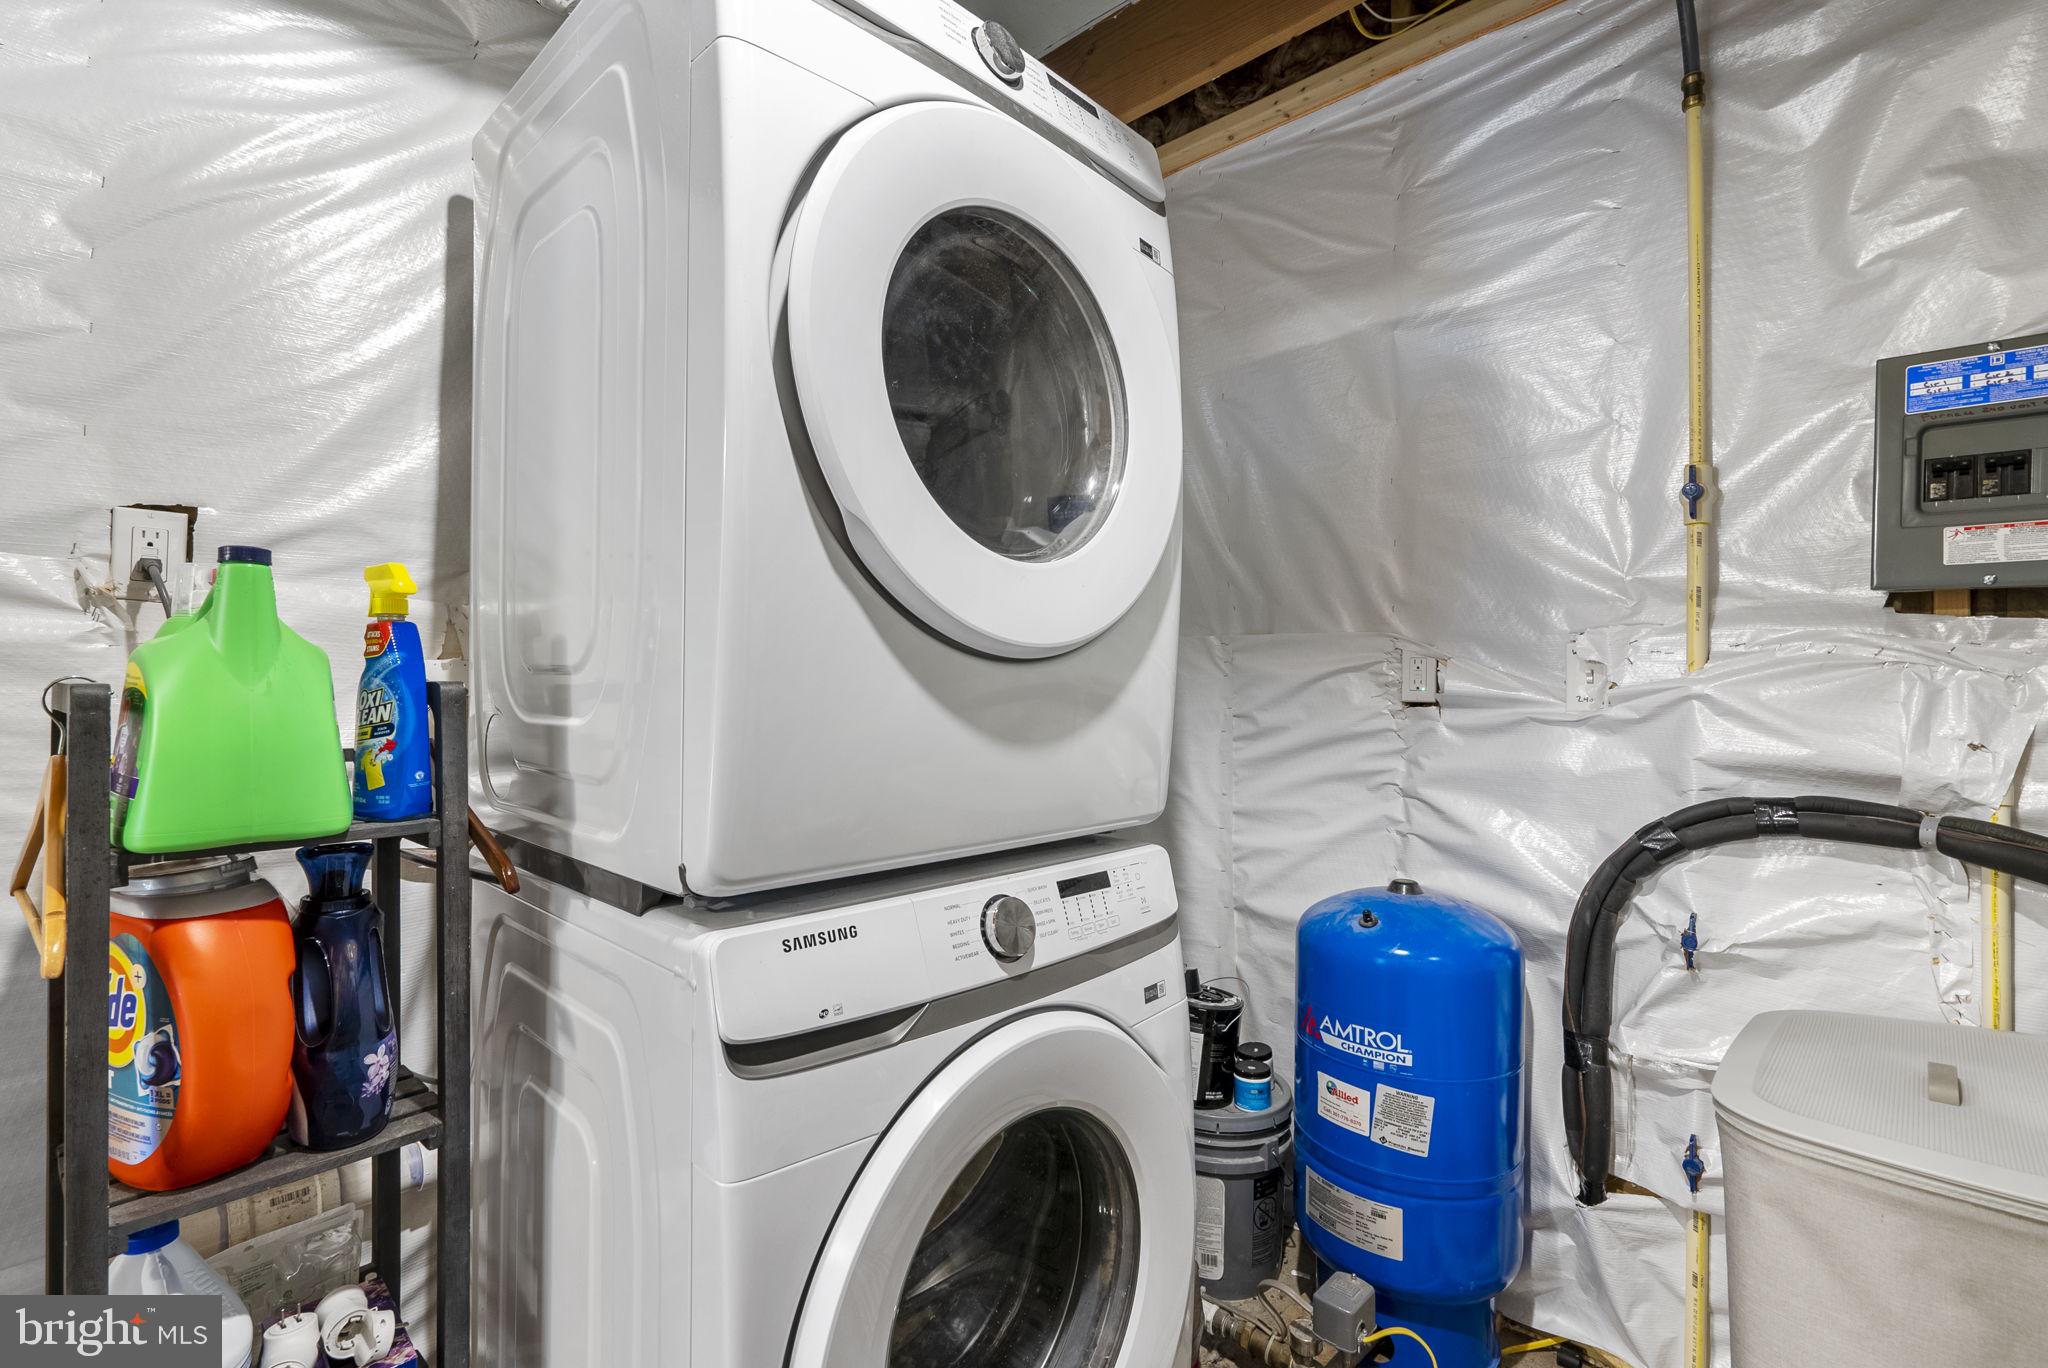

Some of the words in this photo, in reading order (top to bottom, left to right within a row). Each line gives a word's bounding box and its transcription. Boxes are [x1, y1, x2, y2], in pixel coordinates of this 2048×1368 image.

[782, 925, 858, 953] SAMSUNG
[1319, 1014, 1409, 1053] AMTROL
[1341, 1042, 1406, 1064] CHAMPION
[1331, 1087, 1359, 1105] Allied
